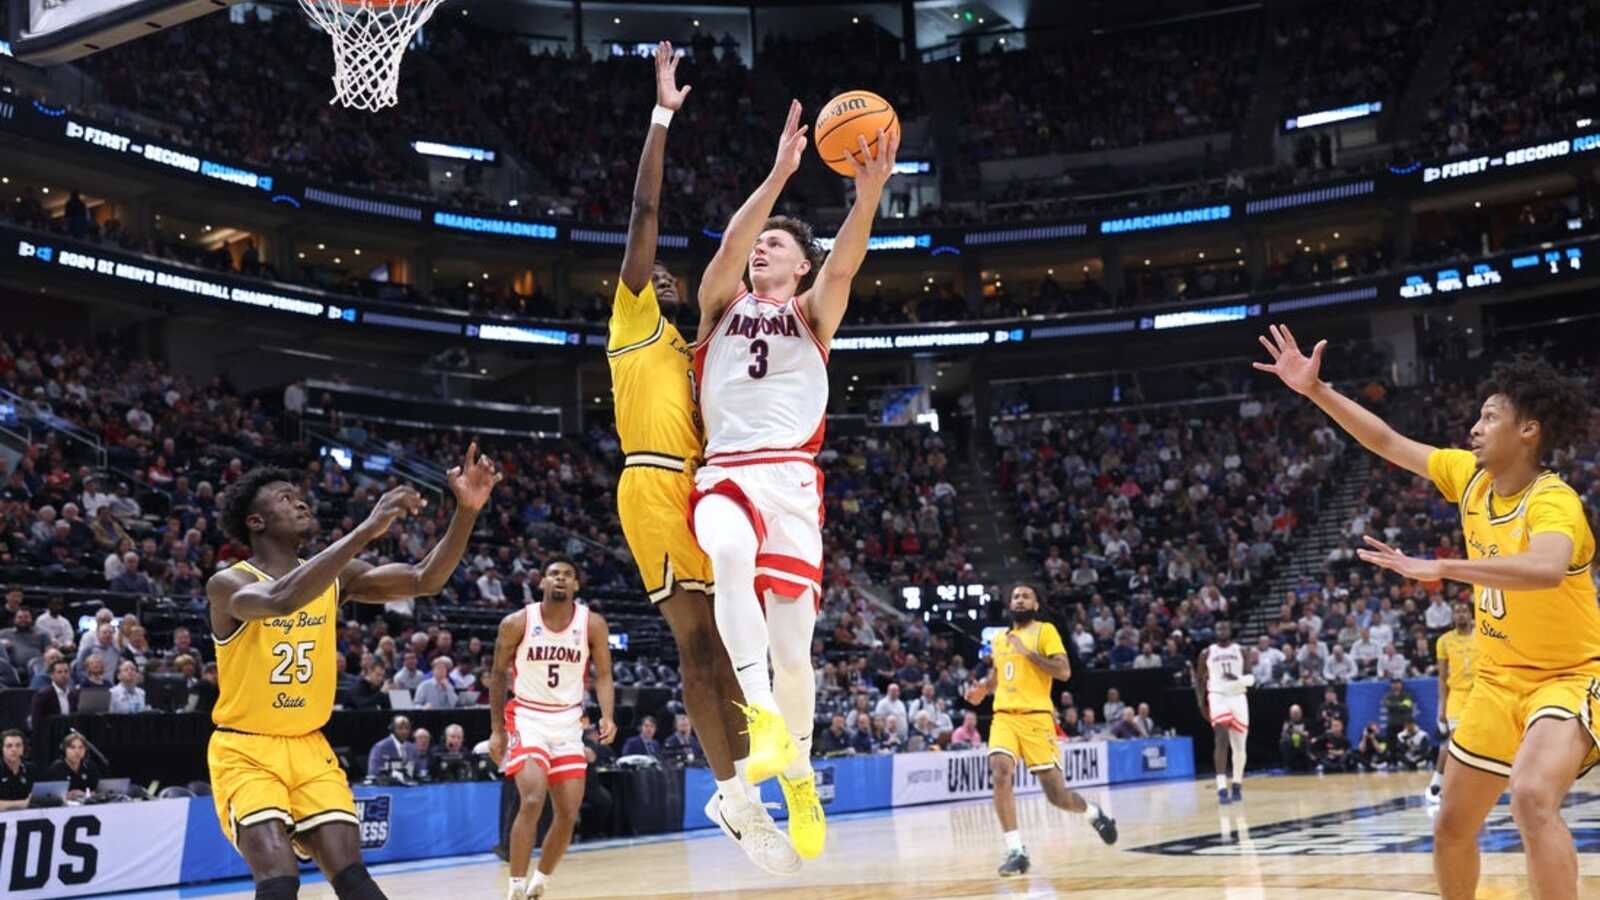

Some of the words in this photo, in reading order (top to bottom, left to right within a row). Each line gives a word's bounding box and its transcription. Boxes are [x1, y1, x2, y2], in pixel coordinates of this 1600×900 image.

[84, 127, 131, 152] FIRST
[144, 144, 200, 173] SECOND
[201, 160, 258, 188] ROUNDS
[1442, 156, 1489, 179] FIRST
[1505, 140, 1570, 166] SECOND
[434, 211, 558, 240] #MARCHMADNESS
[1101, 205, 1231, 234] #MARCHMADNESS
[868, 235, 916, 250] OUNDS
[59, 251, 95, 272] 2024
[116, 264, 155, 284] MEN'S
[156, 273, 230, 300] BASKETBALL
[231, 288, 324, 316] CHAMPIONSHIP
[829, 336, 894, 350] ASKETBALL
[895, 332, 989, 347] CHAMPIONSHIP
[748, 339, 769, 379] 3
[269, 640, 316, 684] 25
[526, 646, 581, 663] ARIZONA
[547, 664, 560, 688] 5
[1003, 661, 1014, 681] 0
[1065, 748, 1099, 782] UTAH
